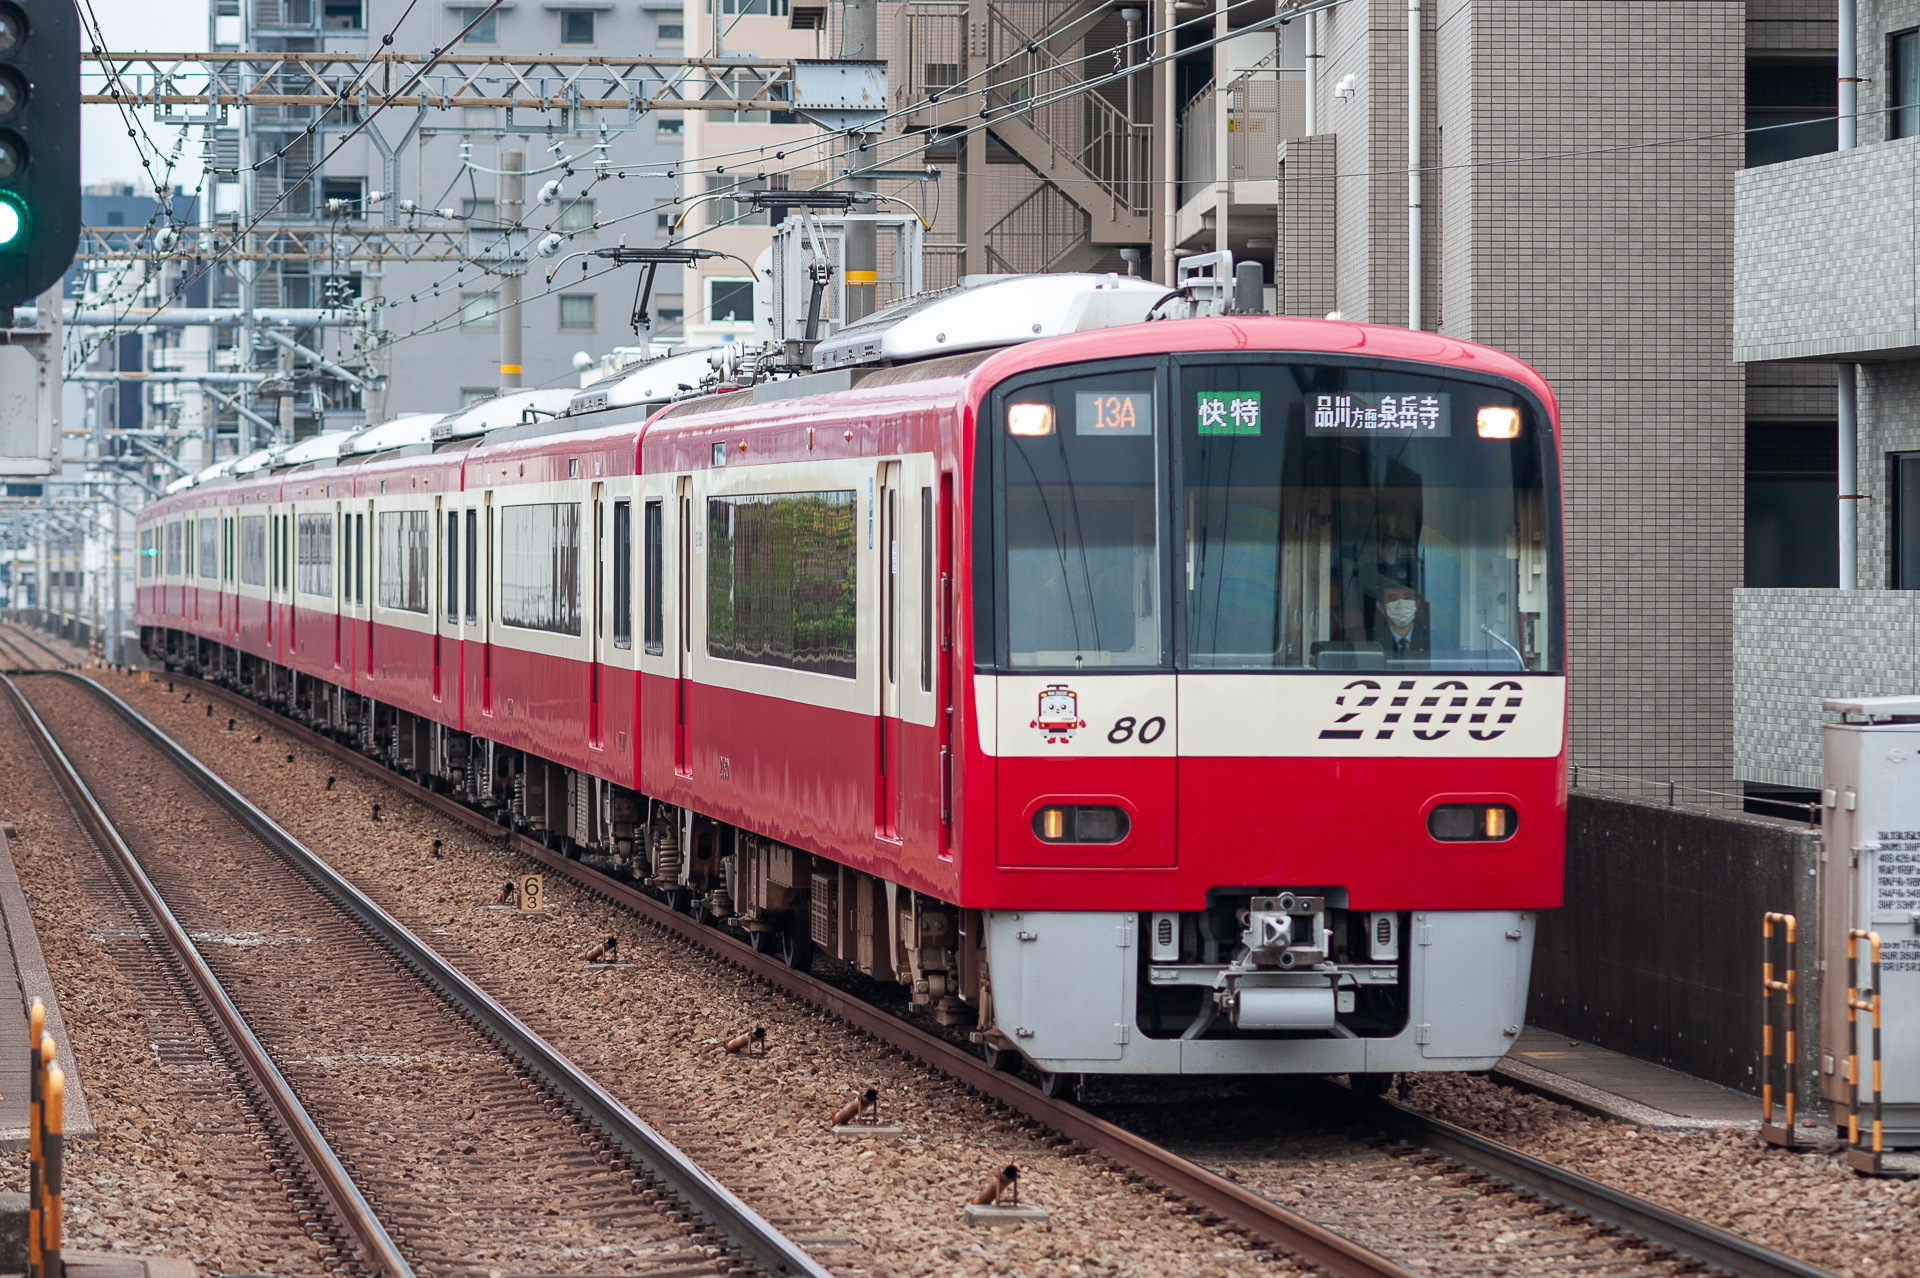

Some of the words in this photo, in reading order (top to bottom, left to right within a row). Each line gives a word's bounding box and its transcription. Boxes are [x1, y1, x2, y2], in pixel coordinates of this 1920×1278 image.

[1093, 396, 1136, 428] 13A
[1198, 397, 1259, 428] 快特
[1318, 680, 1523, 741] 2100
[1107, 716, 1166, 744] 80
[524, 877, 540, 896] 6
[527, 896, 537, 909] 3
